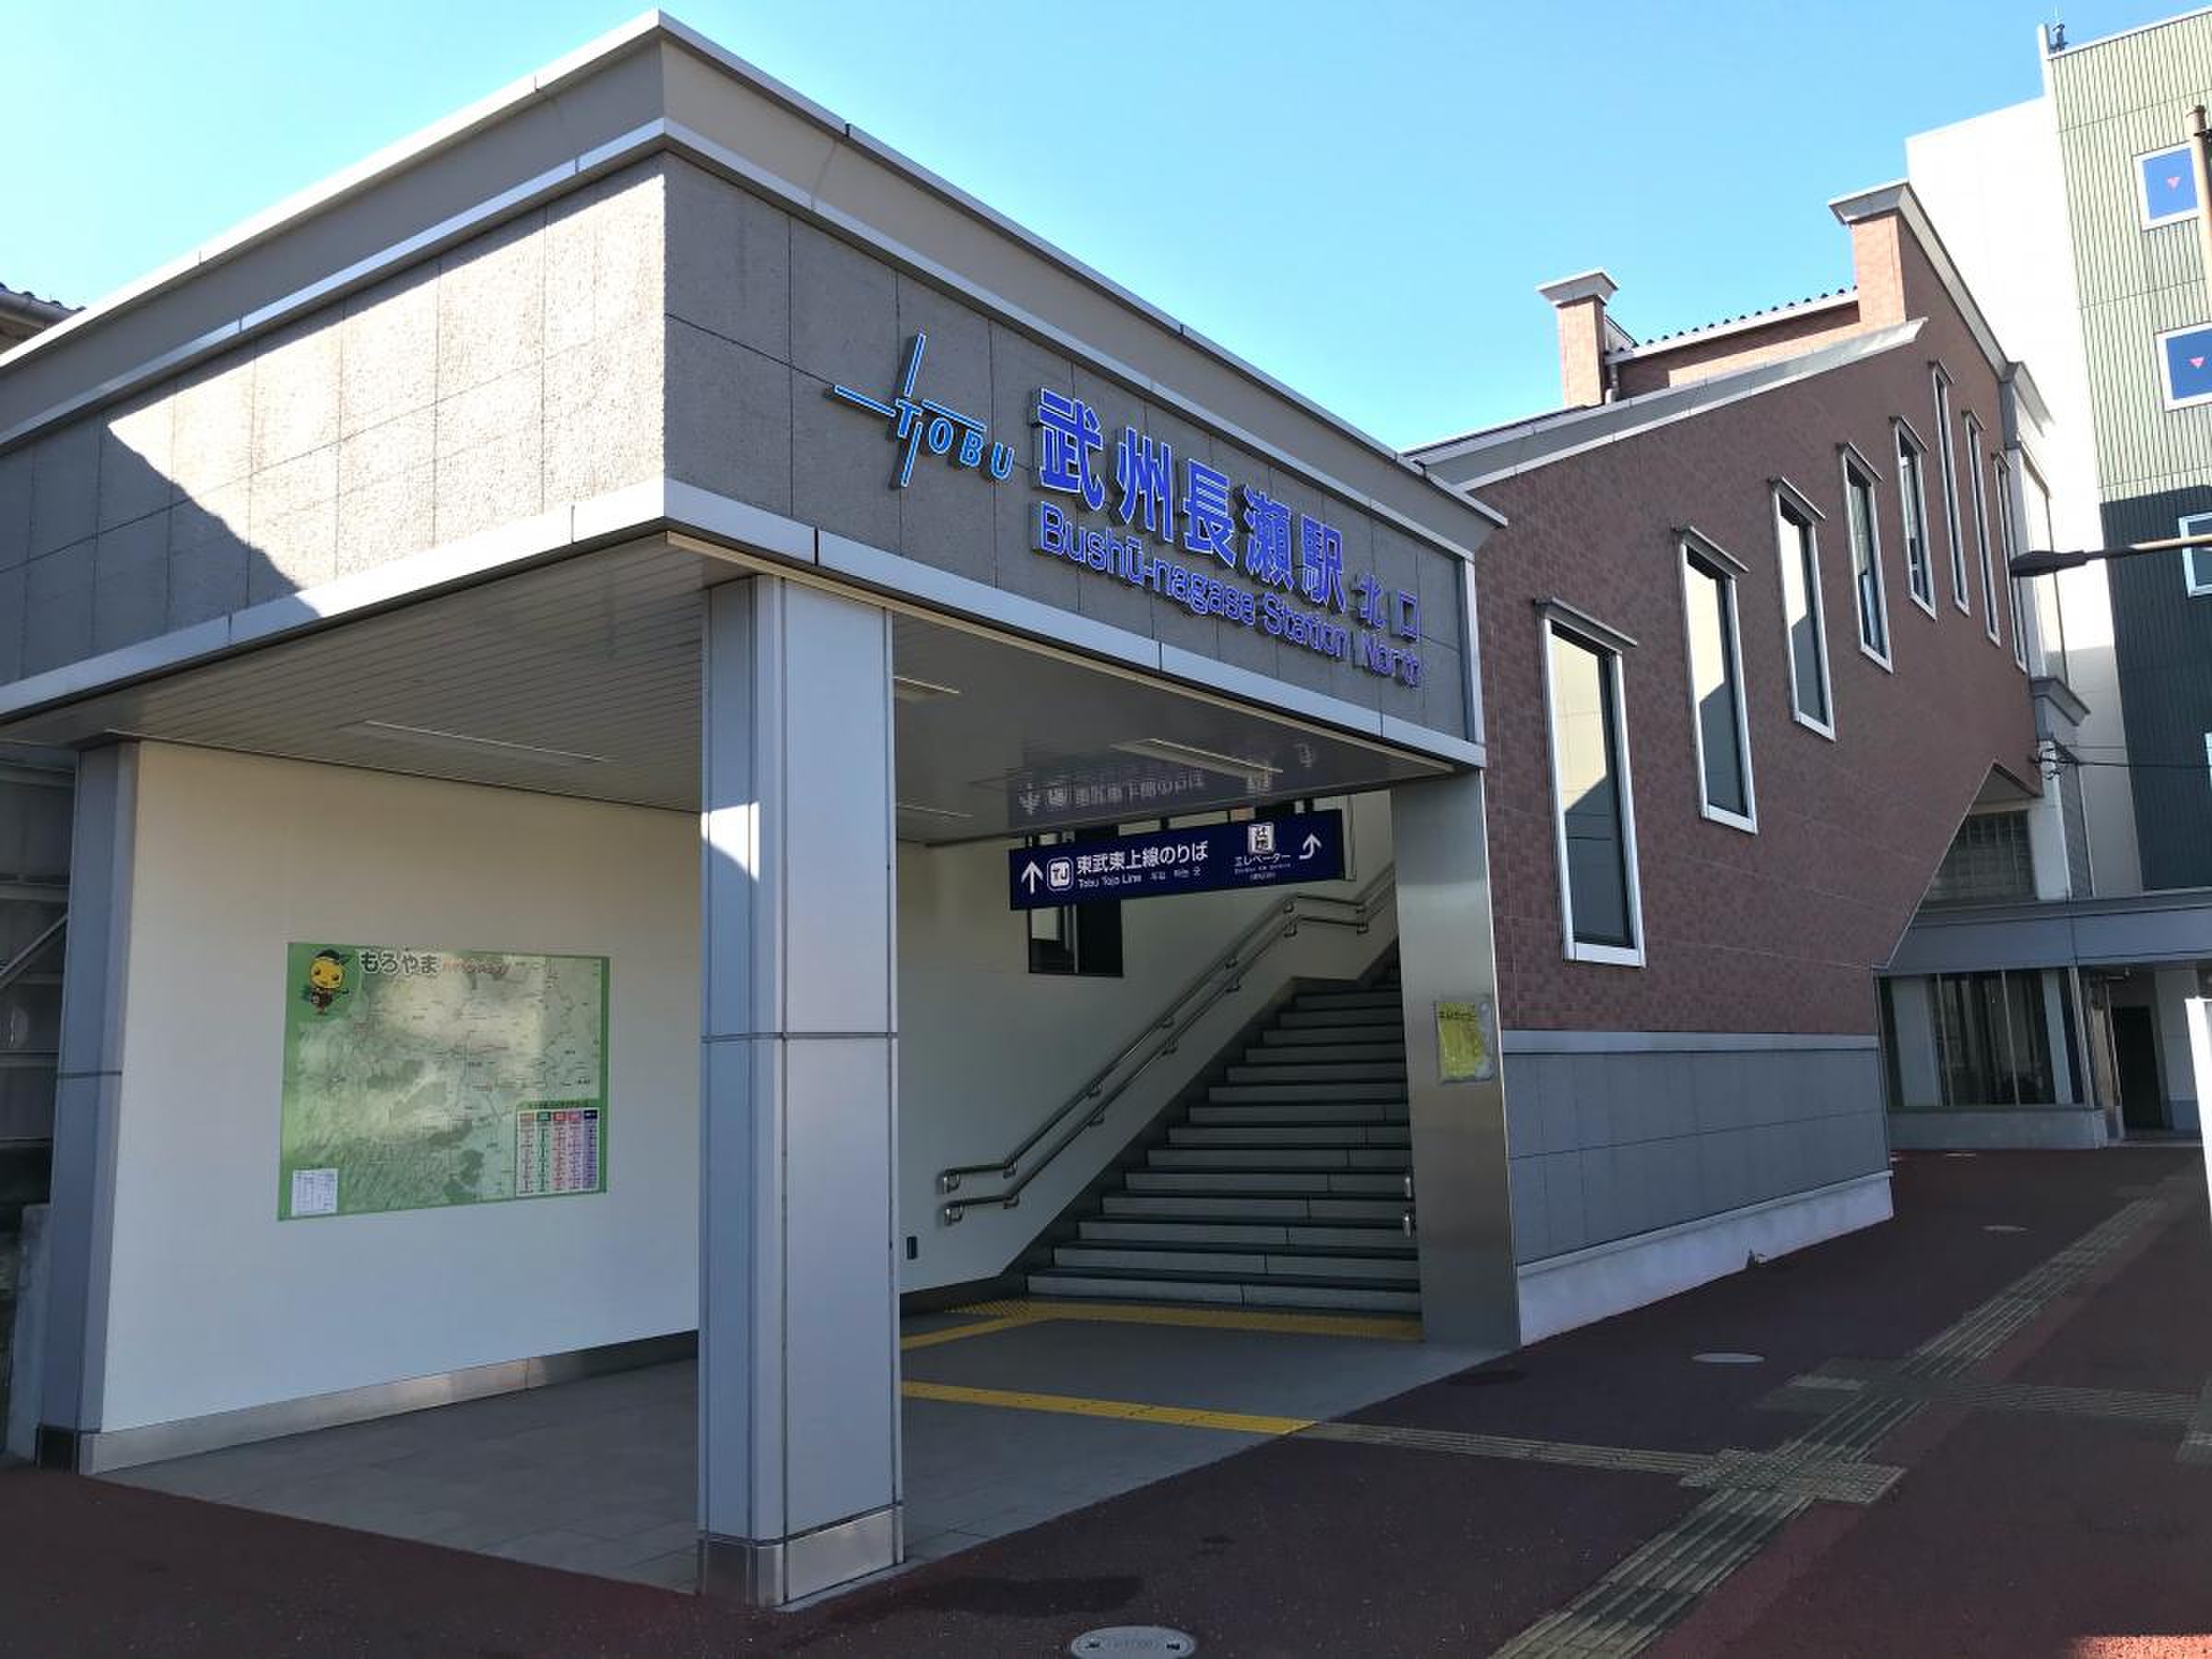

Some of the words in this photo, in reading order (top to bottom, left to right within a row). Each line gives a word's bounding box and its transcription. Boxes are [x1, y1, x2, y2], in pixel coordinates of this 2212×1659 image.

[895, 398, 1015, 480] TOBU
[1037, 386, 1347, 614] 武州長瀬駅
[1357, 574, 1420, 642] 北口
[1040, 500, 1255, 627] Bushū-nagase
[1263, 591, 1348, 658] Station
[1076, 841, 1208, 876] 東武東上線のりば
[1234, 853, 1291, 867] エレベーター
[359, 950, 439, 974] もろやま
